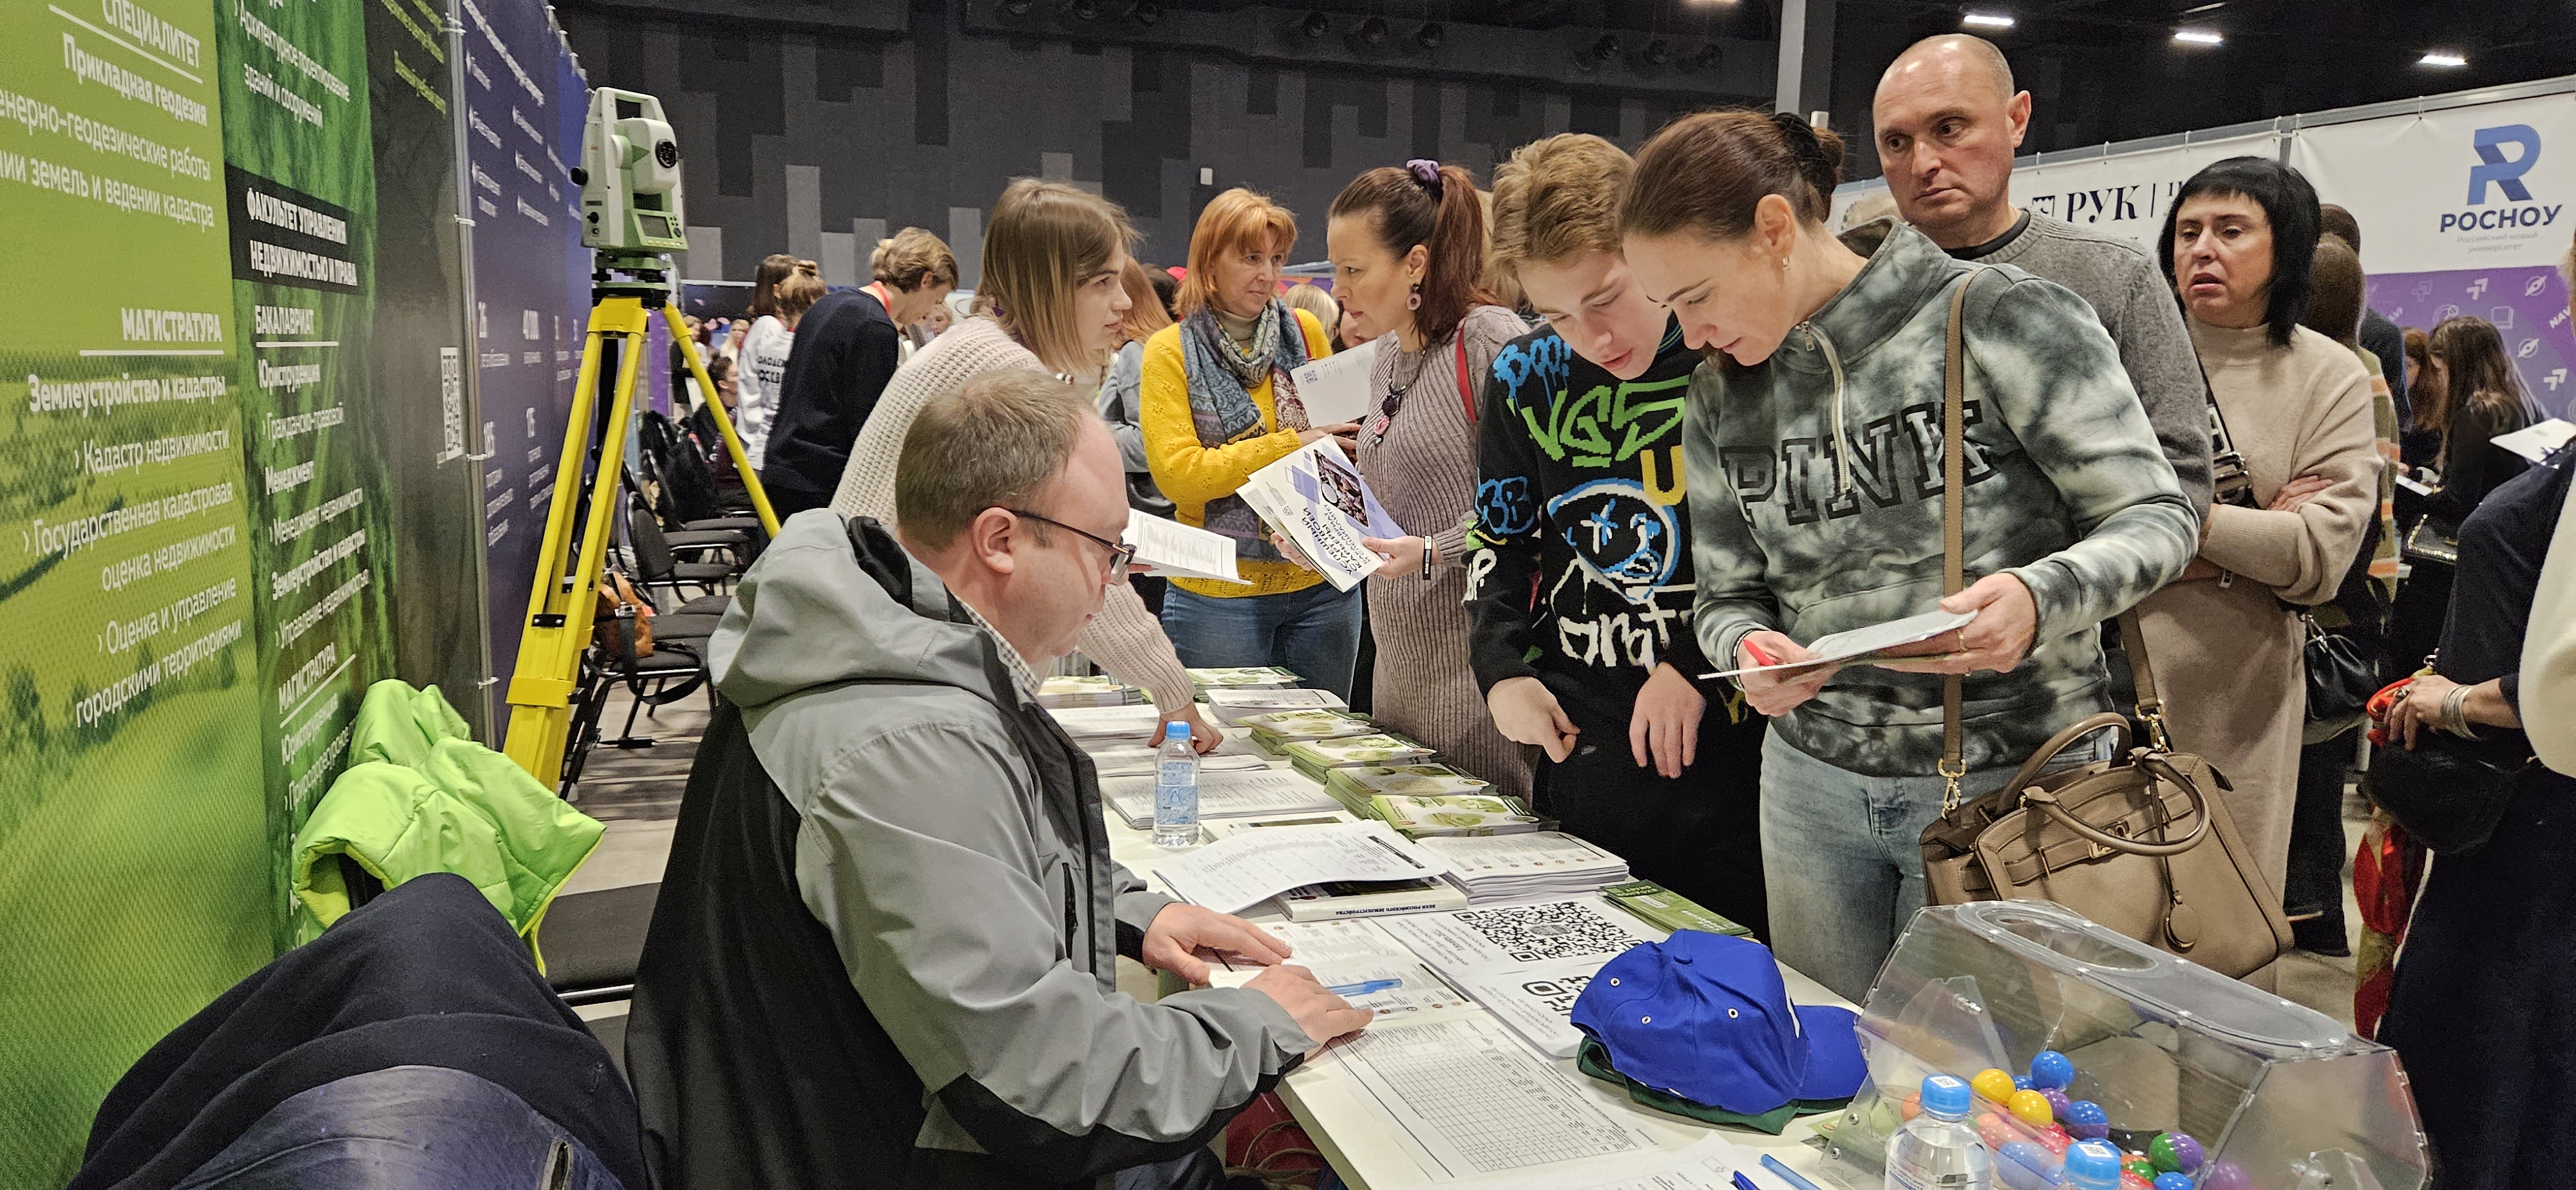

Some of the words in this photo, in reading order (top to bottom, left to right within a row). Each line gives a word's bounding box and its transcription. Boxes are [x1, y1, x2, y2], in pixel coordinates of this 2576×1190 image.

[102, 0, 200, 69] СПЕЦИАЛИТЕТ
[62, 32, 154, 104] Прикладная
[155, 84, 207, 127] геодезия
[170, 147, 211, 182] работы
[30, 158, 89, 198] земель
[92, 175, 102, 201] и
[105, 178, 161, 214] ведении
[163, 193, 215, 234] кадастра
[246, 187, 298, 231] ФАКУЛЬТЕТ
[2067, 185, 2141, 223] РУК
[2439, 204, 2563, 233] РОСНОУ
[121, 307, 223, 343] МАГИСТРАТУРА
[255, 305, 315, 335] БАКАЛАВРИАТ
[2548, 305, 2571, 330] NAV
[28, 372, 160, 419] Землеустройство
[161, 378, 171, 401] и
[172, 375, 225, 404] кадастры
[83, 439, 144, 475] Кадастр
[146, 430, 230, 466] недвижимости
[1719, 399, 2000, 529] PINK
[33, 500, 161, 560] Государственная
[163, 482, 234, 518] кадастровая
[1303, 507, 1329, 542] ТВОЕЙ
[102, 552, 152, 592] оценка
[153, 525, 236, 573] недвижимости
[1302, 517, 1353, 576] УСПЕШНЫЙ
[1321, 524, 1363, 569] КАРЬЕРЫ
[1330, 542, 1358, 572] СТАРТ
[106, 612, 159, 655] Оценка
[160, 605, 169, 631] и
[171, 577, 237, 634] управление
[76, 660, 162, 728] городскими
[162, 619, 242, 681] территориями
[278, 641, 337, 714] МАГИСТРАТУРА
